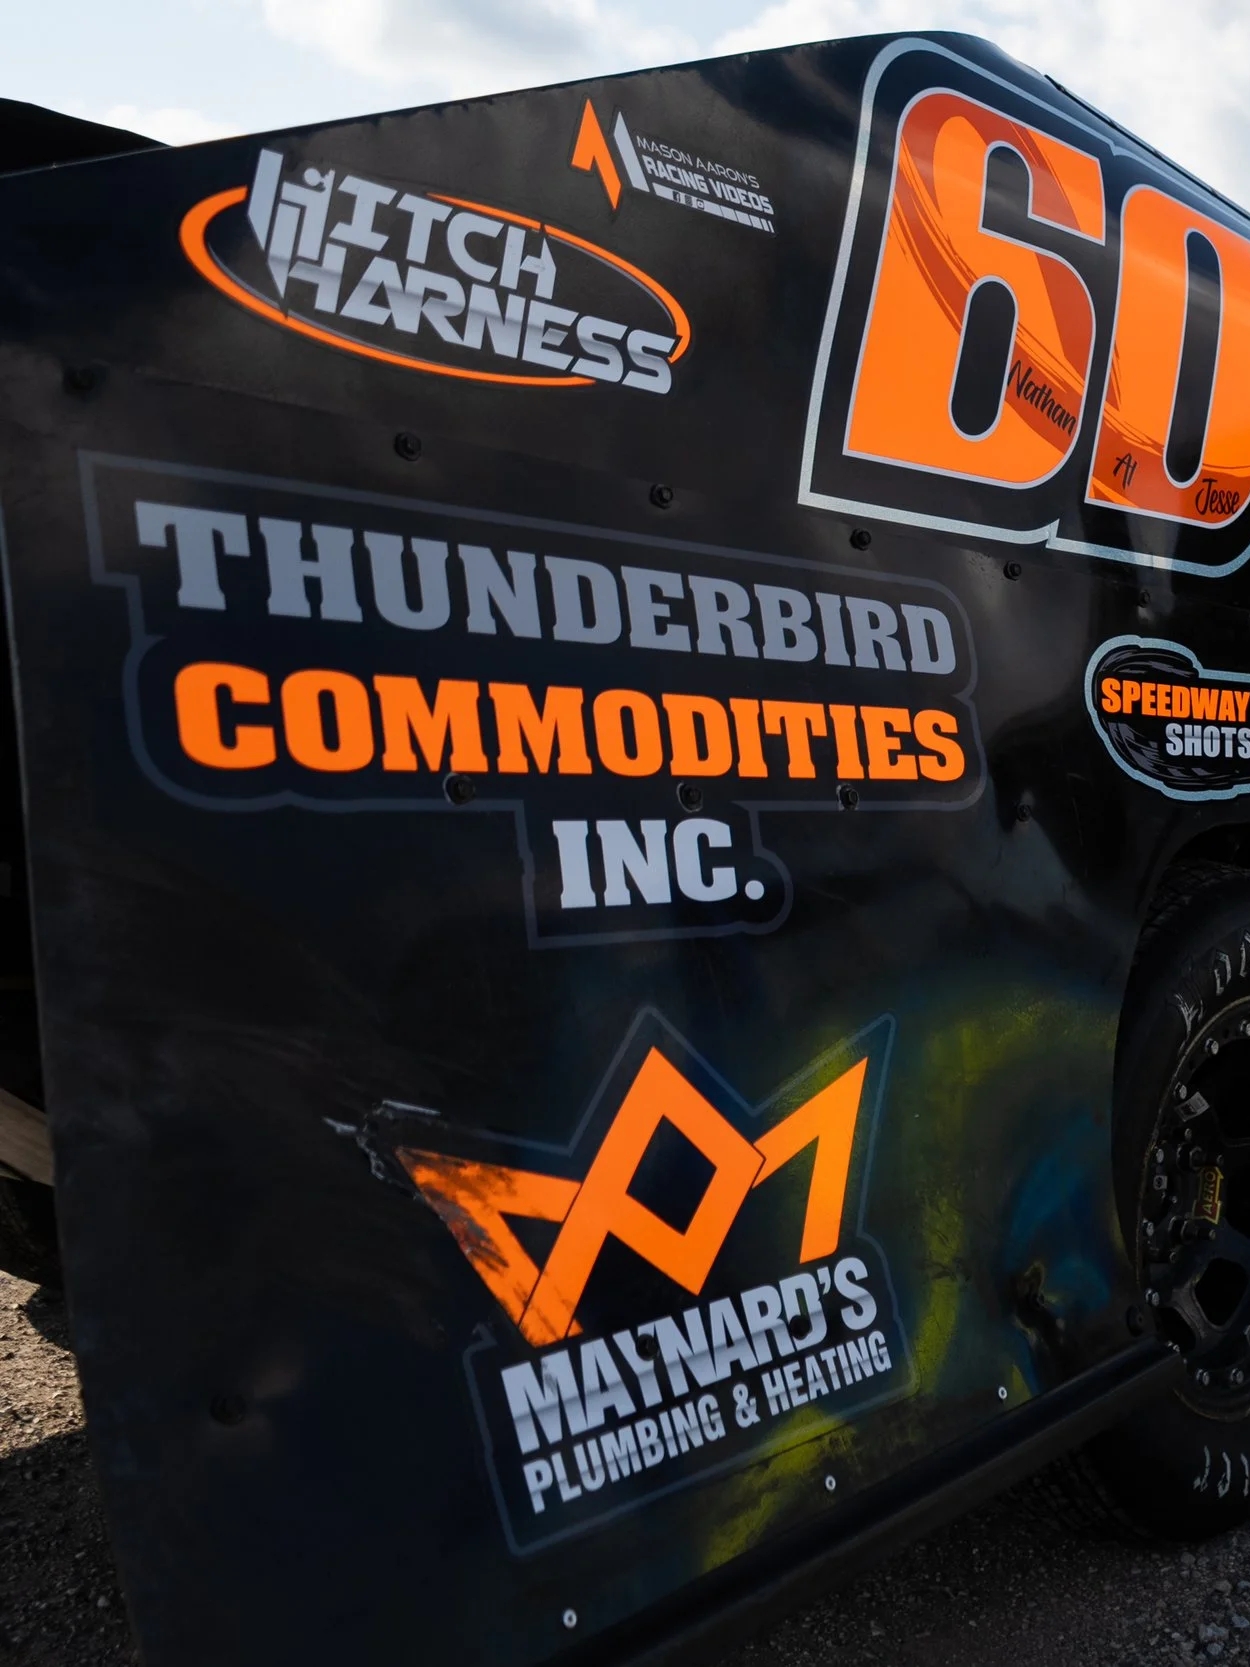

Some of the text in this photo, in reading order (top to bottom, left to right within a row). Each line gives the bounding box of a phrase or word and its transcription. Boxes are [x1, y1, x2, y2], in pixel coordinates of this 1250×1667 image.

[636, 135, 760, 189] MASON AARON'S
[642, 154, 774, 215] RACING VIDEOS
[268, 202, 673, 395] HARNESS
[1007, 359, 1077, 437] Nathan
[1195, 478, 1240, 515] Jesse
[135, 501, 958, 675] THUNDERBIRD
[174, 661, 966, 782] COMMODITIES
[1101, 678, 1250, 723] SPEEDWAY
[552, 817, 766, 910] INC.
[1202, 1169, 1217, 1215] AERO
[500, 1257, 878, 1455] MAYNARD'S
[523, 1330, 893, 1515] PLUMBING & HEATING
